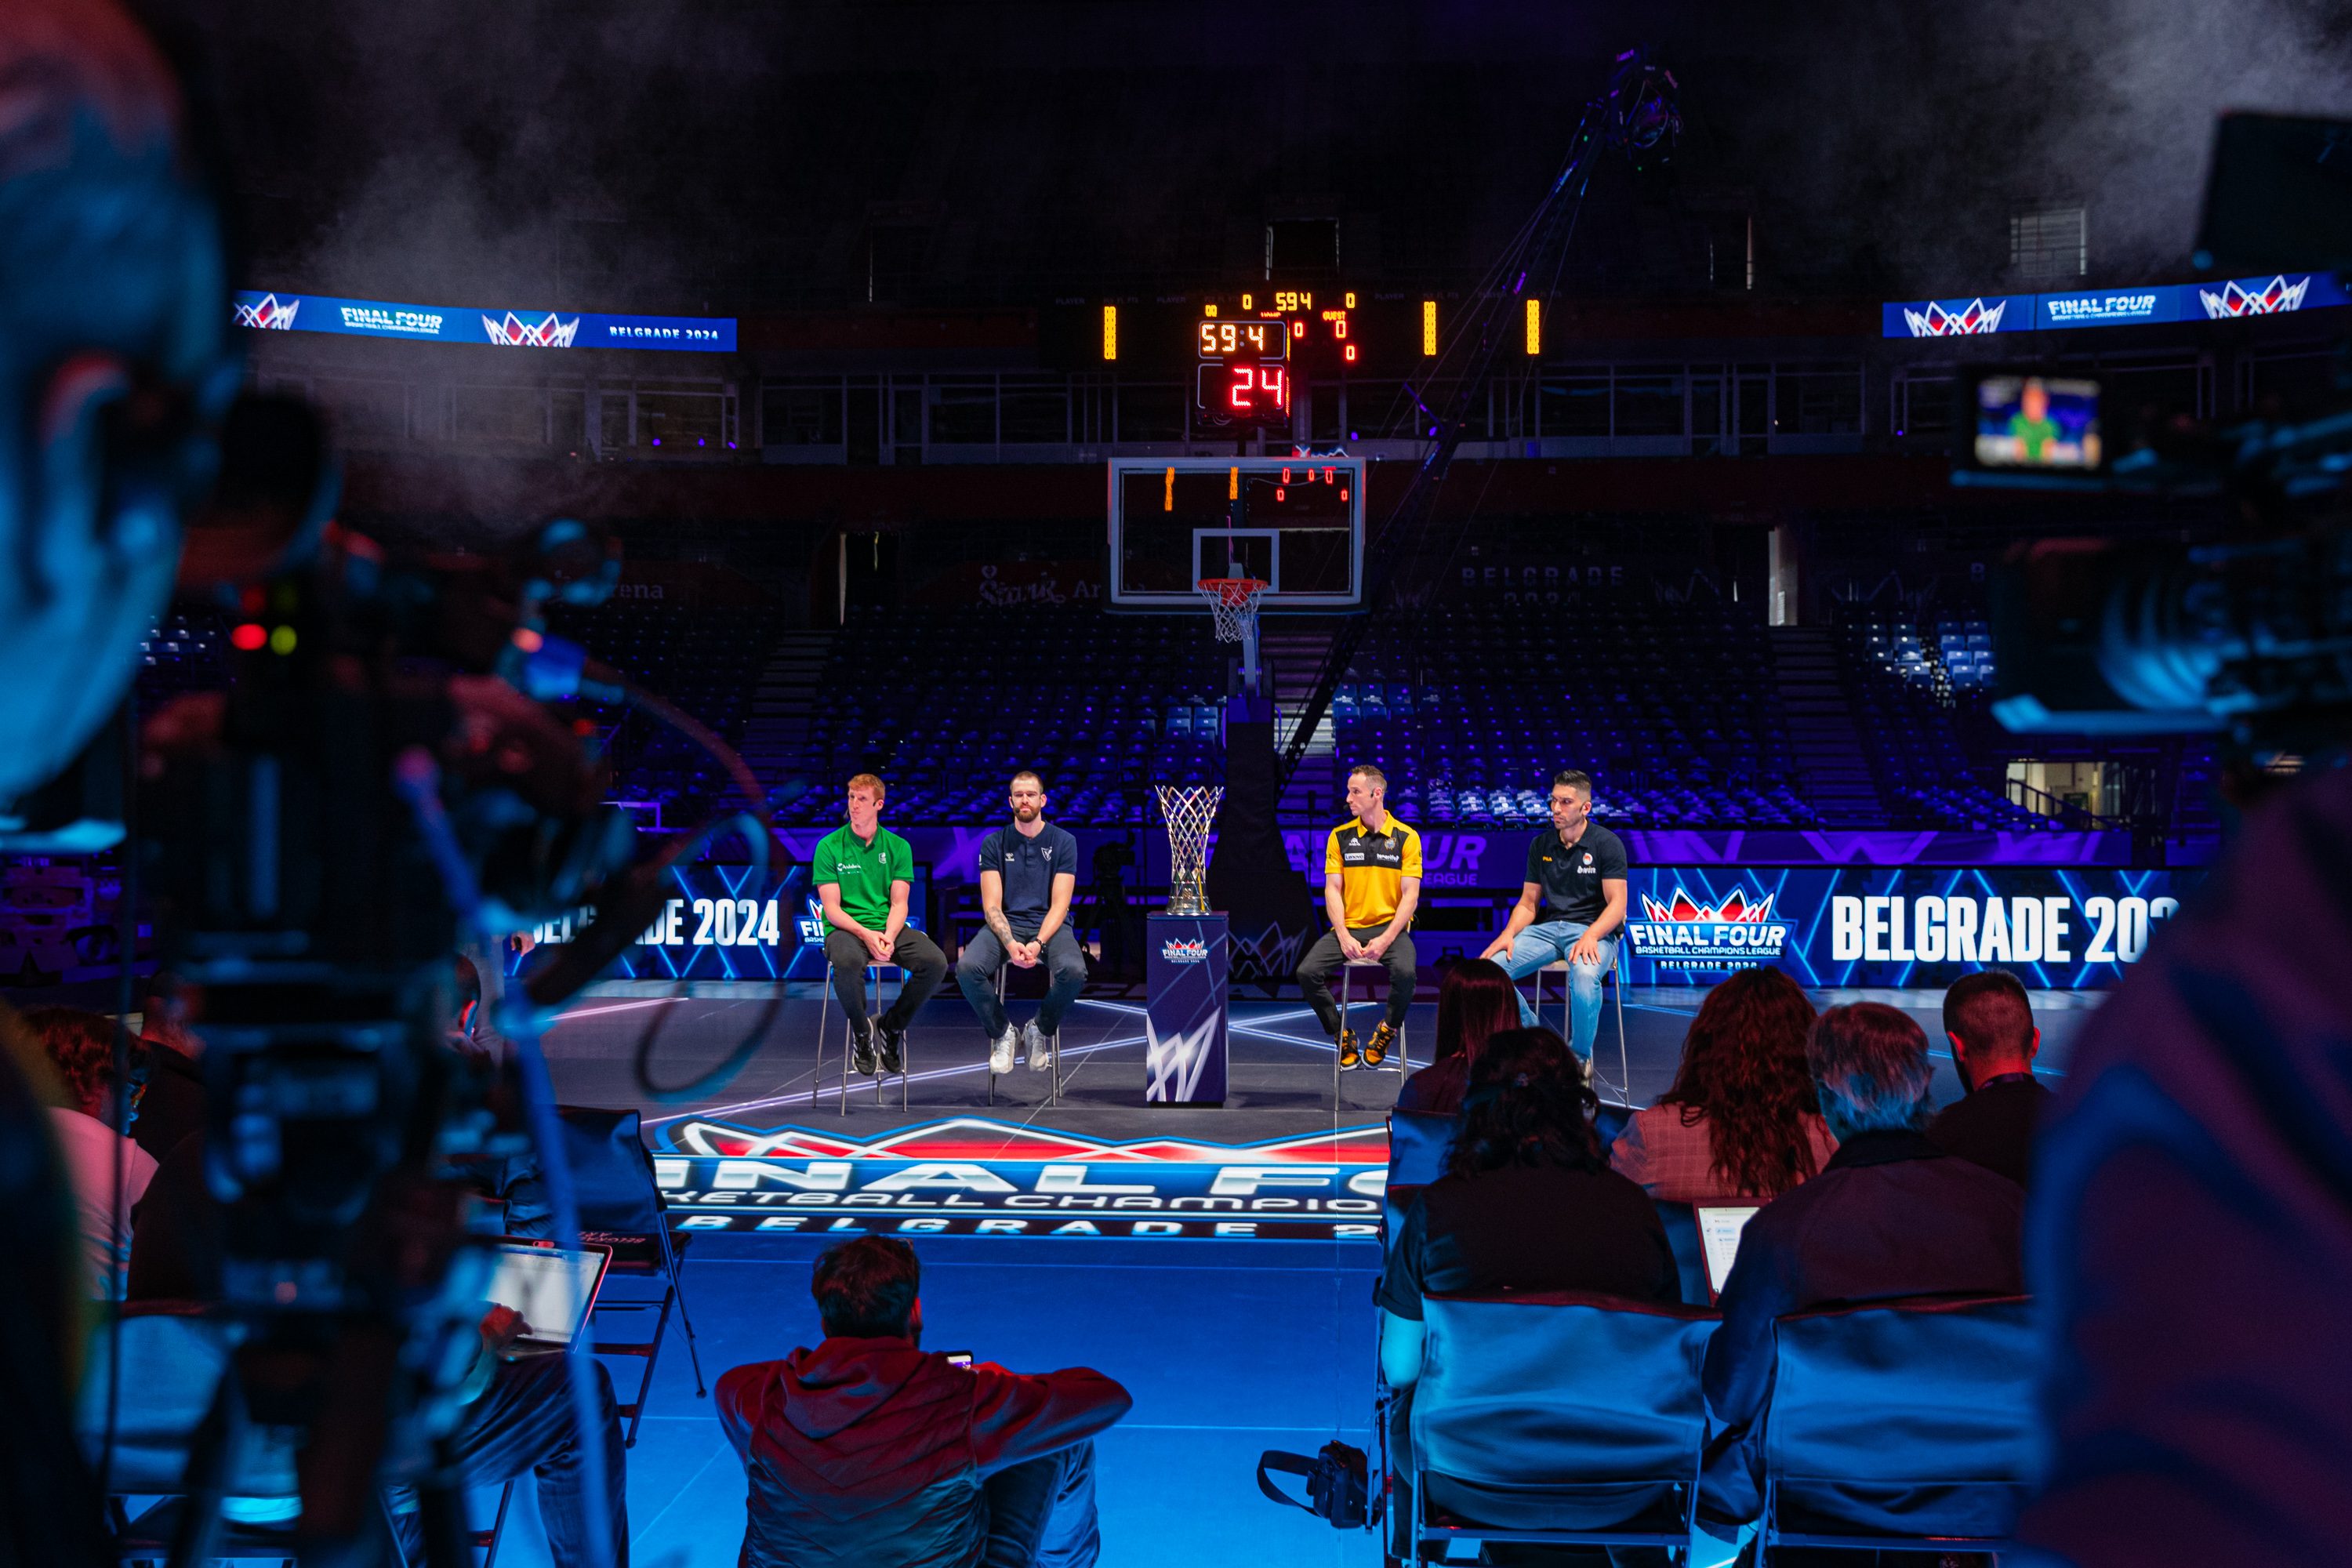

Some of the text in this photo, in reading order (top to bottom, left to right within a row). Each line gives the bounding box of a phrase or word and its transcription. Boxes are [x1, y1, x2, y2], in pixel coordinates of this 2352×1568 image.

[1243, 294, 1252, 310] 0
[1345, 292, 1355, 309] 0
[2048, 298, 2103, 316] FINAL
[2105, 295, 2156, 313] FOUR
[340, 307, 394, 325] FINAL
[395, 311, 443, 328] FOUR
[1322, 310, 1346, 321] GUEST
[609, 326, 719, 340] BELGRADE 2024
[1294, 322, 1304, 337] 0
[1335, 321, 1346, 339] 0
[1345, 346, 1356, 361] 0
[1232, 368, 1283, 407] 24
[1461, 565, 1624, 586] BELGRADE
[1421, 834, 1487, 870] UR
[1577, 866, 1596, 874] bwin
[692, 898, 779, 946] 2024
[1832, 896, 2071, 962] BELGRADE
[1629, 924, 1787, 946] FINAL FOUR
[1635, 946, 1780, 955] BASKETBALL CHAMPIONS LEAGUE
[1661, 960, 1722, 970] BELGRADE
[655, 1159, 1156, 1193] INAL
[663, 1190, 1377, 1211] KETBALL CHAMPIO
[675, 1215, 1258, 1238] BELGRADE
